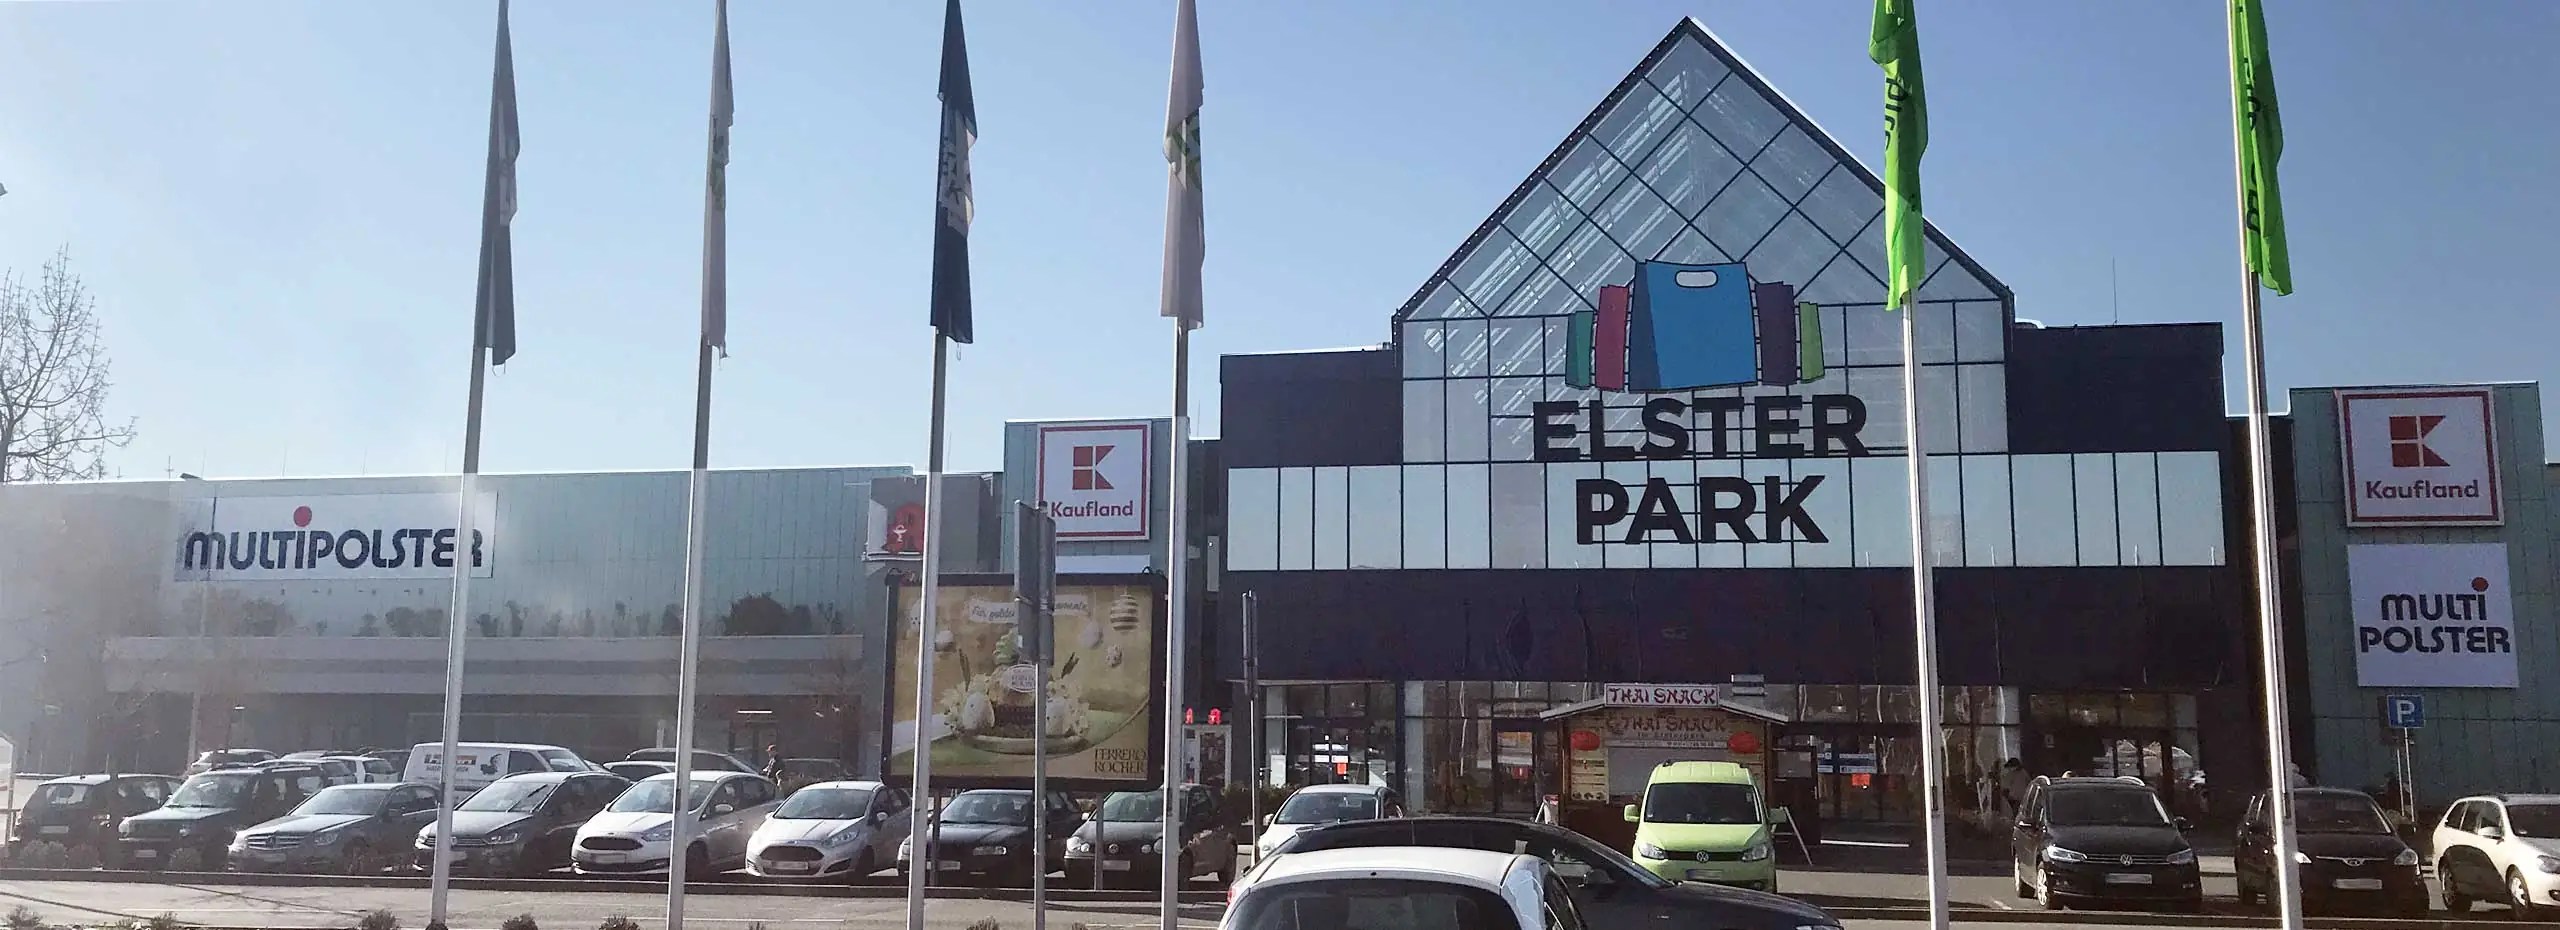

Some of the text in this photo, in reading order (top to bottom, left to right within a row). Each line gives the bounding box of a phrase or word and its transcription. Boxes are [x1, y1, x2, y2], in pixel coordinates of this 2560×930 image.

[1533, 394, 1871, 461] ELSTER
[2366, 479, 2479, 499] Kaufland
[1051, 500, 1133, 517] Kaufland
[1576, 475, 1829, 544] PARK
[2359, 626, 2510, 654] POLSTER
[1608, 687, 1715, 705] THAI SNACK
[2397, 700, 2415, 723] P
[1094, 748, 1147, 761] FERRERO
[1094, 760, 1145, 774] ROCHER
